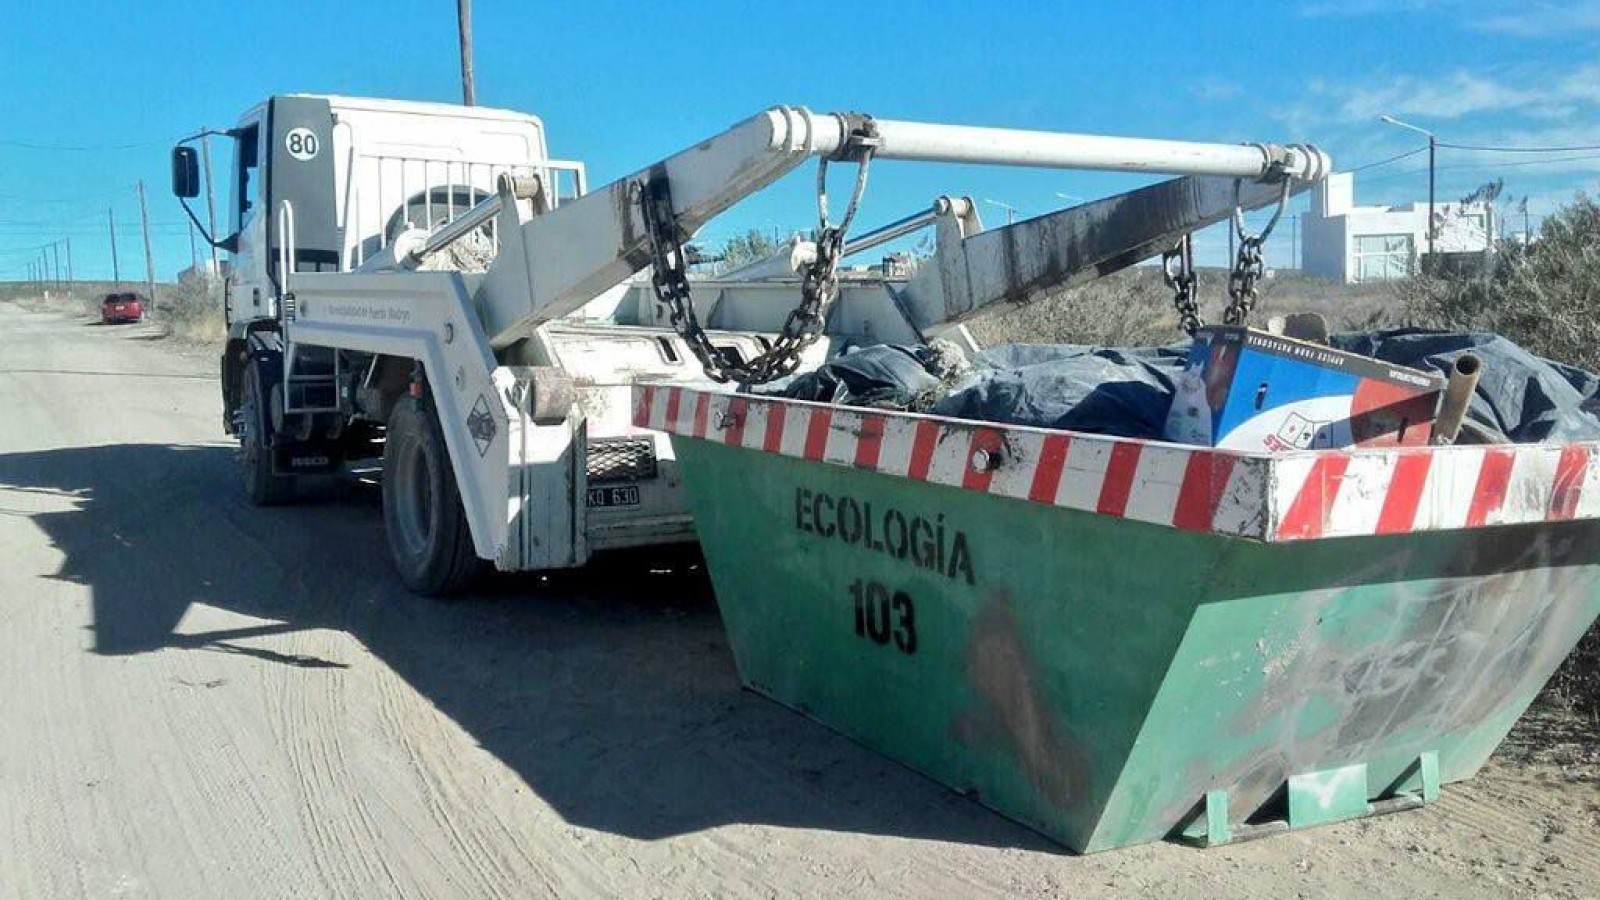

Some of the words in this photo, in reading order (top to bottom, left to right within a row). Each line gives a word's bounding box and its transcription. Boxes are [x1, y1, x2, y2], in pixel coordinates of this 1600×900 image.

[290, 133, 316, 154] 80
[612, 487, 637, 504] 630
[795, 486, 976, 585] ECOLOGÍA
[848, 577, 918, 656] 103
